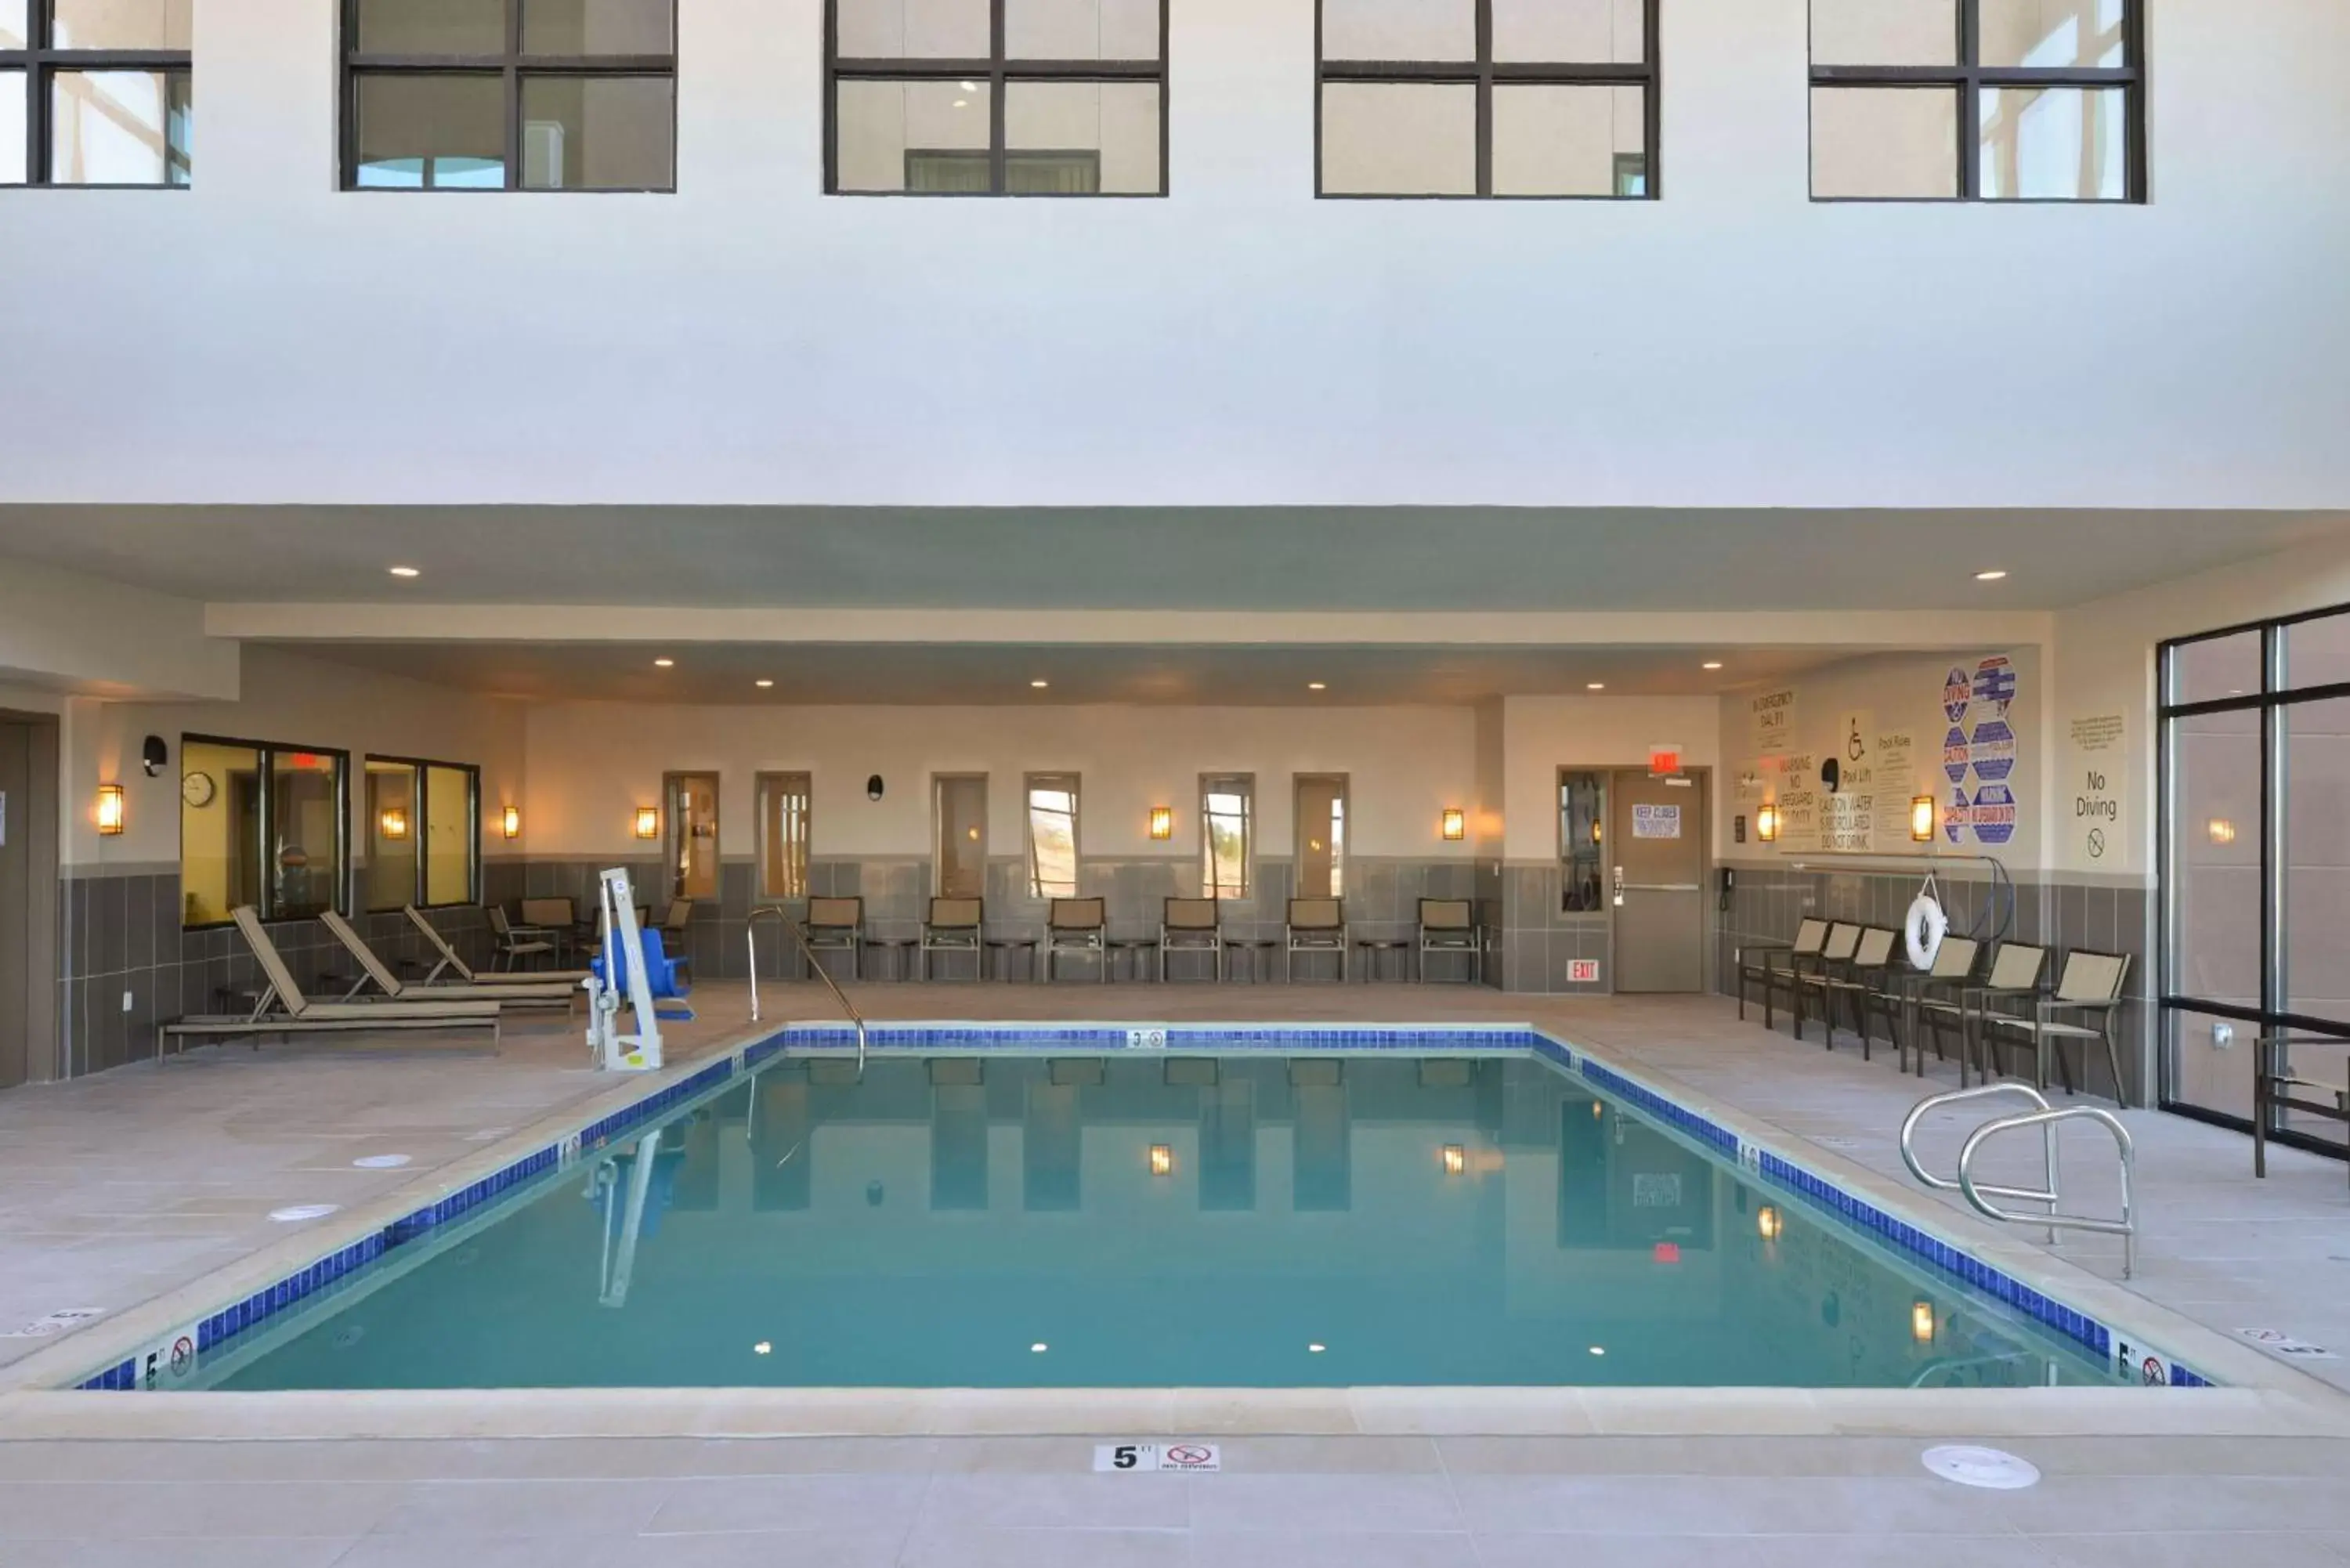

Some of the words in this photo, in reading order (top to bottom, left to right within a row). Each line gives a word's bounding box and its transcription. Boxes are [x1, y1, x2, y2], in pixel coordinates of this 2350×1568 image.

[1790, 775, 1801, 789] NO
[1842, 769, 1856, 783] Pool
[2088, 771, 2105, 790] No
[2077, 796, 2117, 821] Diving
[1574, 961, 1596, 978] EXIT
[1113, 1445, 1137, 1469] 5
